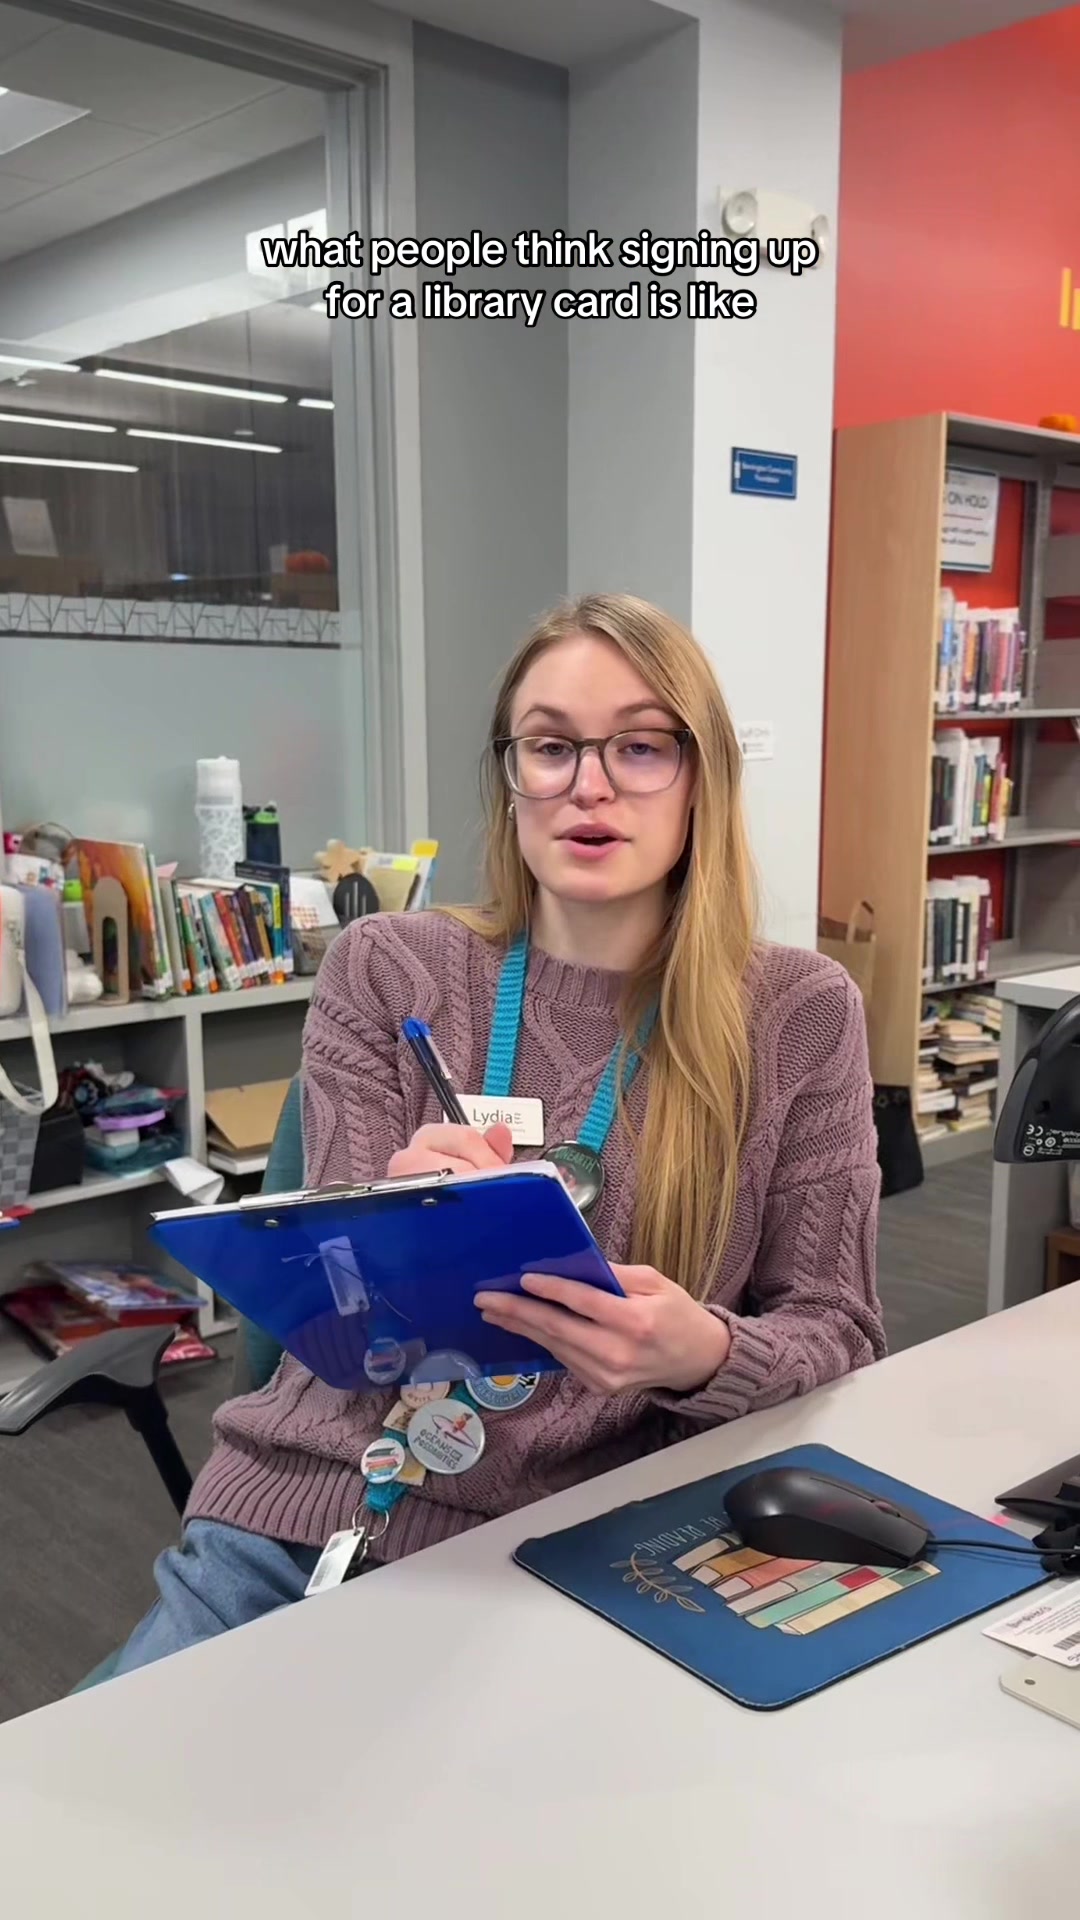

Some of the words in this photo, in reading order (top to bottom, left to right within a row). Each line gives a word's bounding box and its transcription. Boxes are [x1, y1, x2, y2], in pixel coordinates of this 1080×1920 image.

[473, 1108, 513, 1126] Lydia
[419, 1428, 452, 1454] OCEANS
[700, 1515, 729, 1531] BE
[633, 1524, 707, 1557] READING
